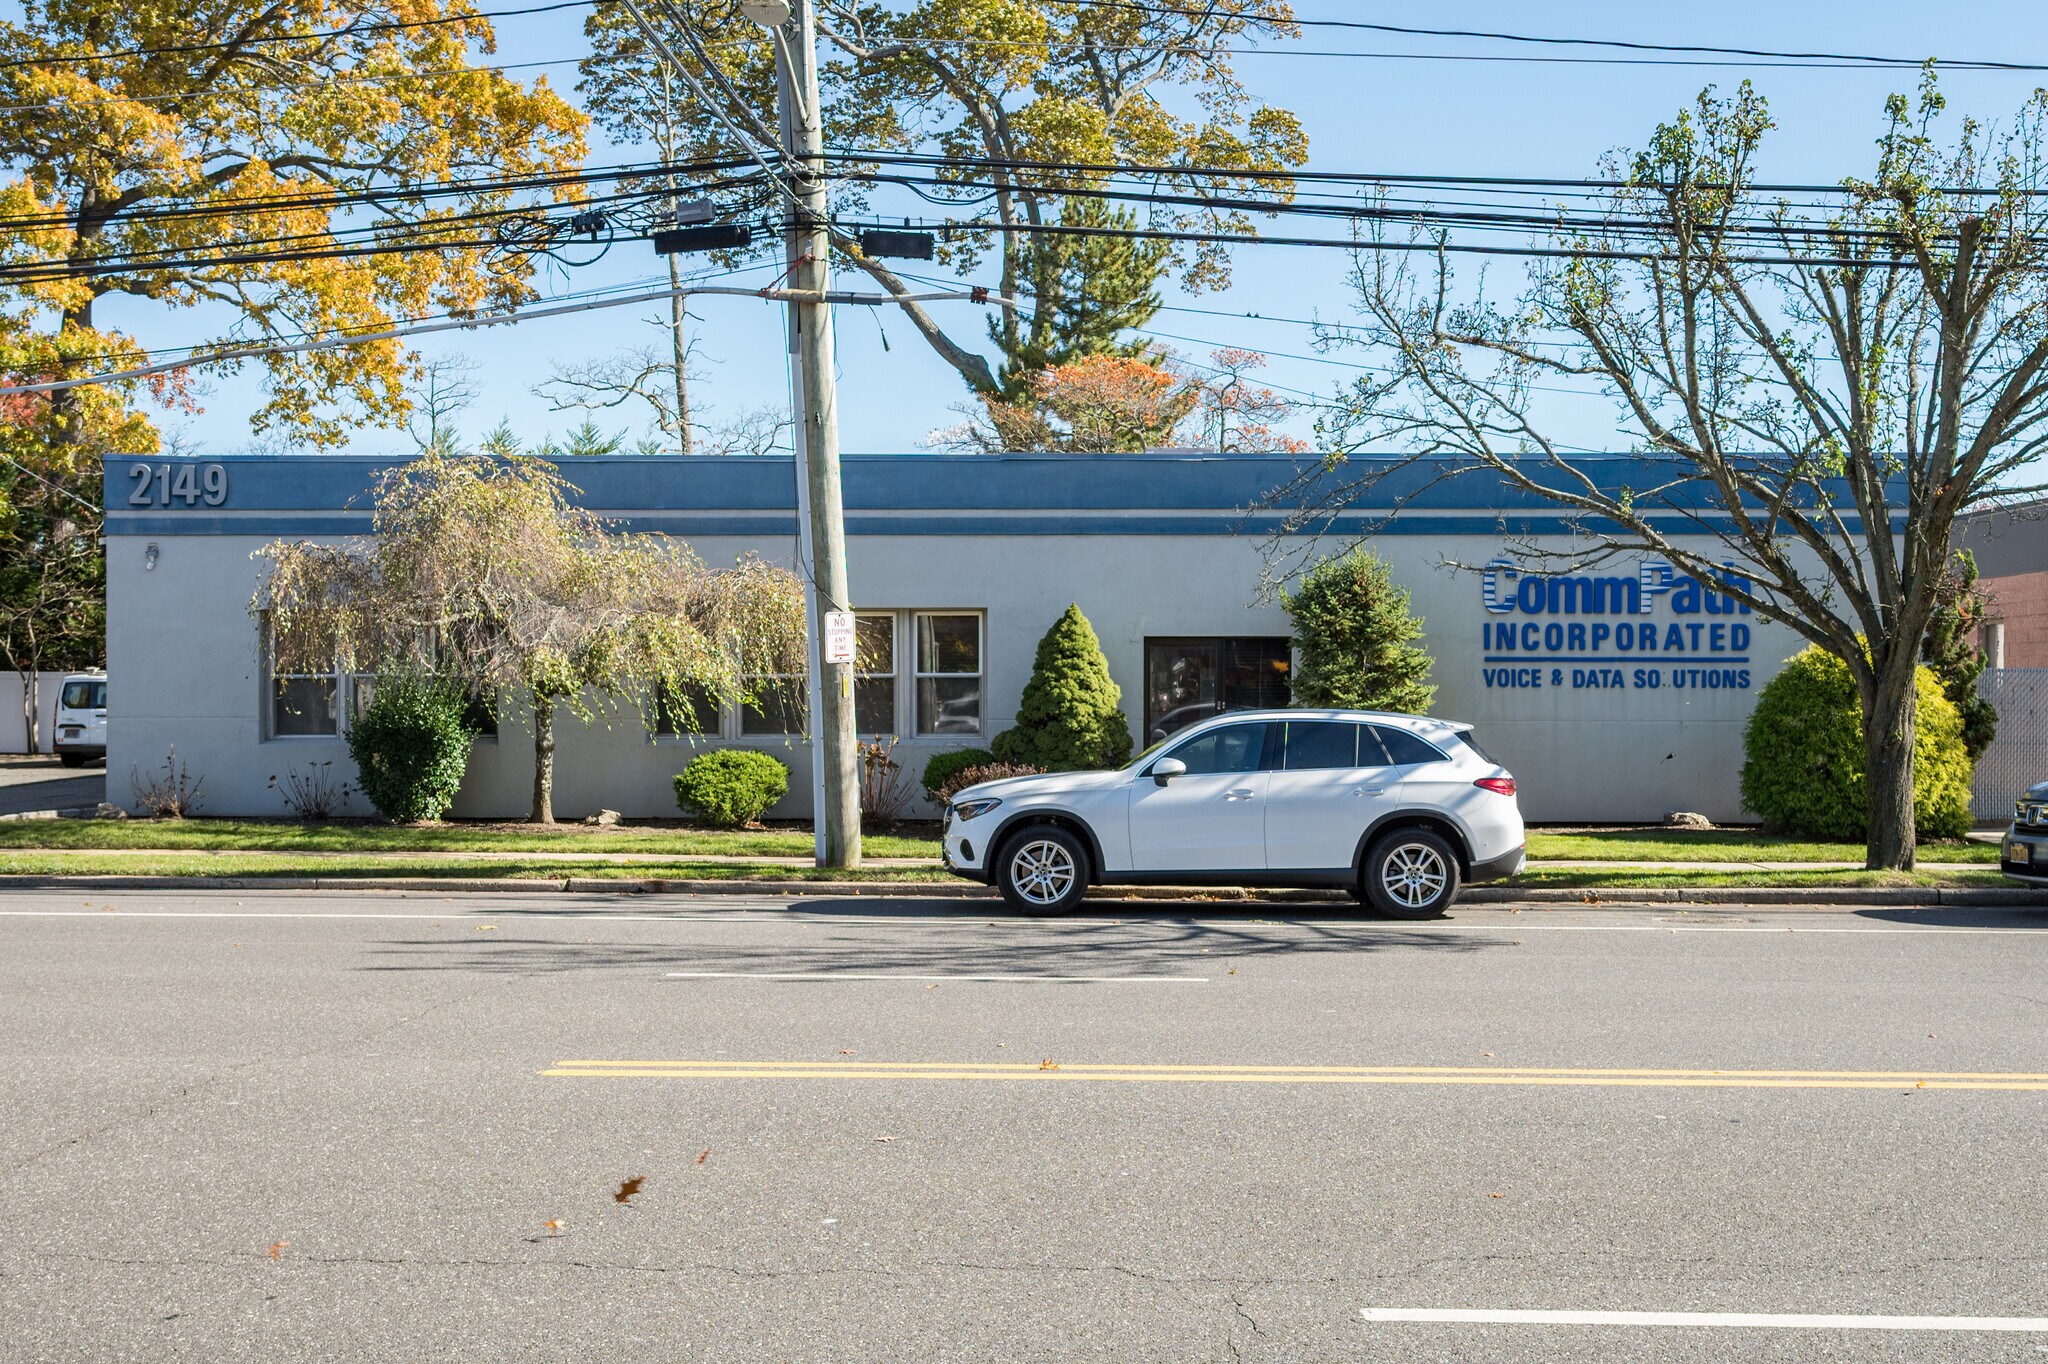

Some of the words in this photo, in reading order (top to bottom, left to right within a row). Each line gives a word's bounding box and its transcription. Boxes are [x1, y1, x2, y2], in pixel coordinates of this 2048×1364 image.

[129, 463, 228, 506] 2149
[1483, 560, 1752, 615] CommPath
[828, 628, 853, 636] STOPPING
[834, 617, 846, 627] NO
[1483, 623, 1750, 651] INCORPORATED
[1483, 668, 1542, 688] VOICE
[1551, 668, 1564, 687] &
[1572, 668, 1625, 689] DATA
[1633, 668, 1751, 689] SOUTIONS
